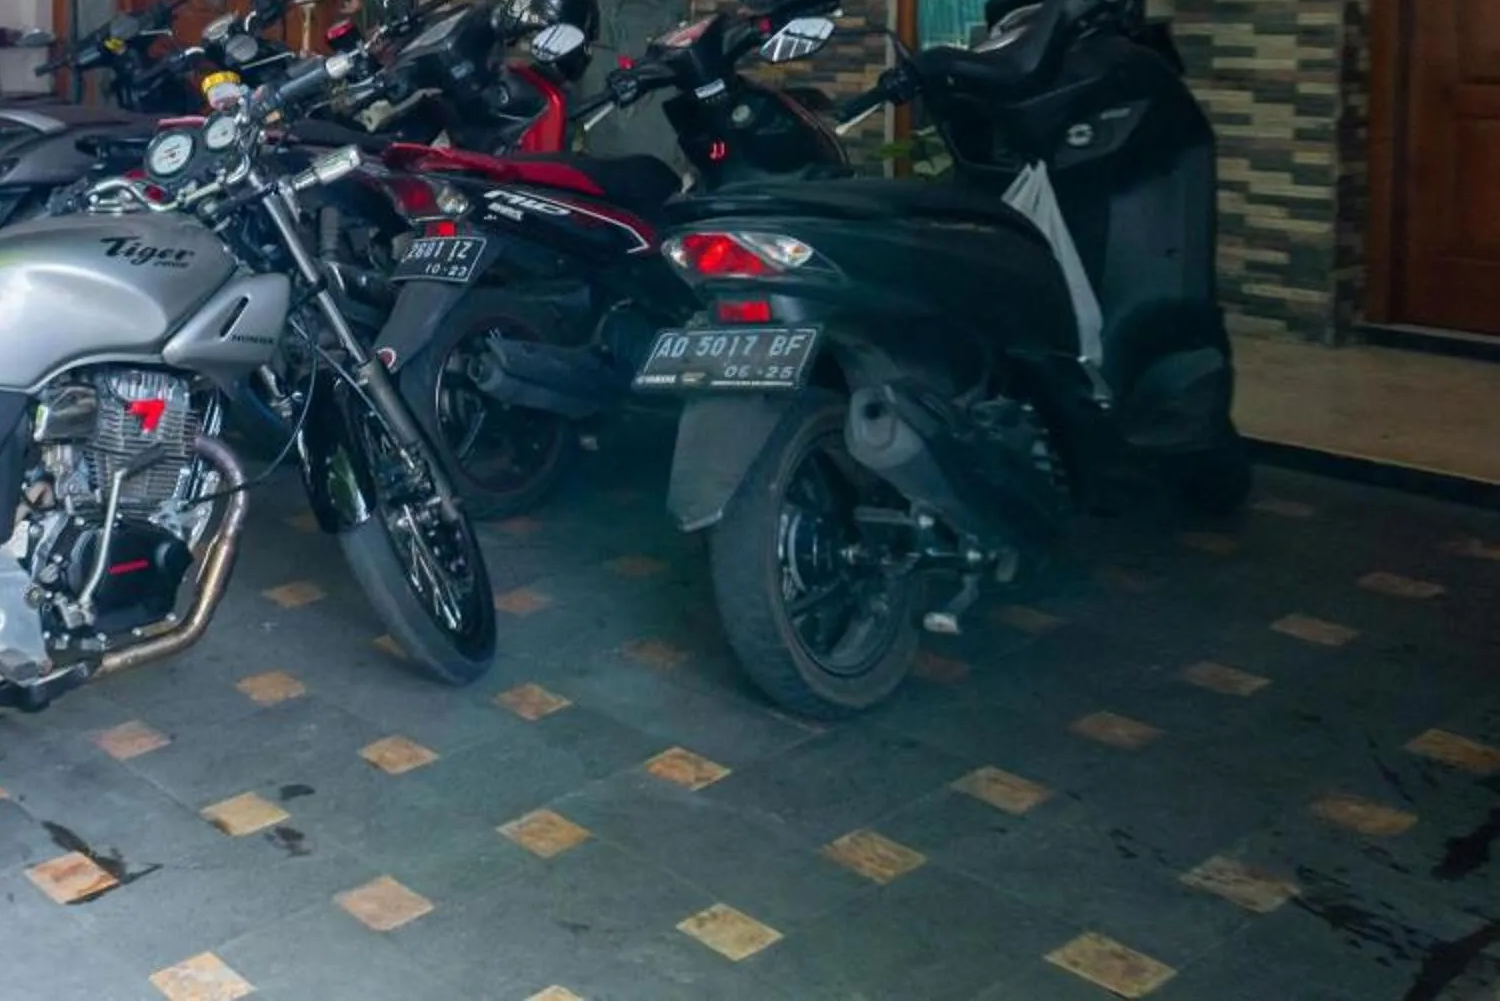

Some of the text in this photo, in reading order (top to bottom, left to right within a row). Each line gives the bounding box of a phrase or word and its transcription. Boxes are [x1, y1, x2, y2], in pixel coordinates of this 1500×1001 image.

[100, 235, 196, 266] Tiger
[654, 334, 806, 359] AD 5017 BF
